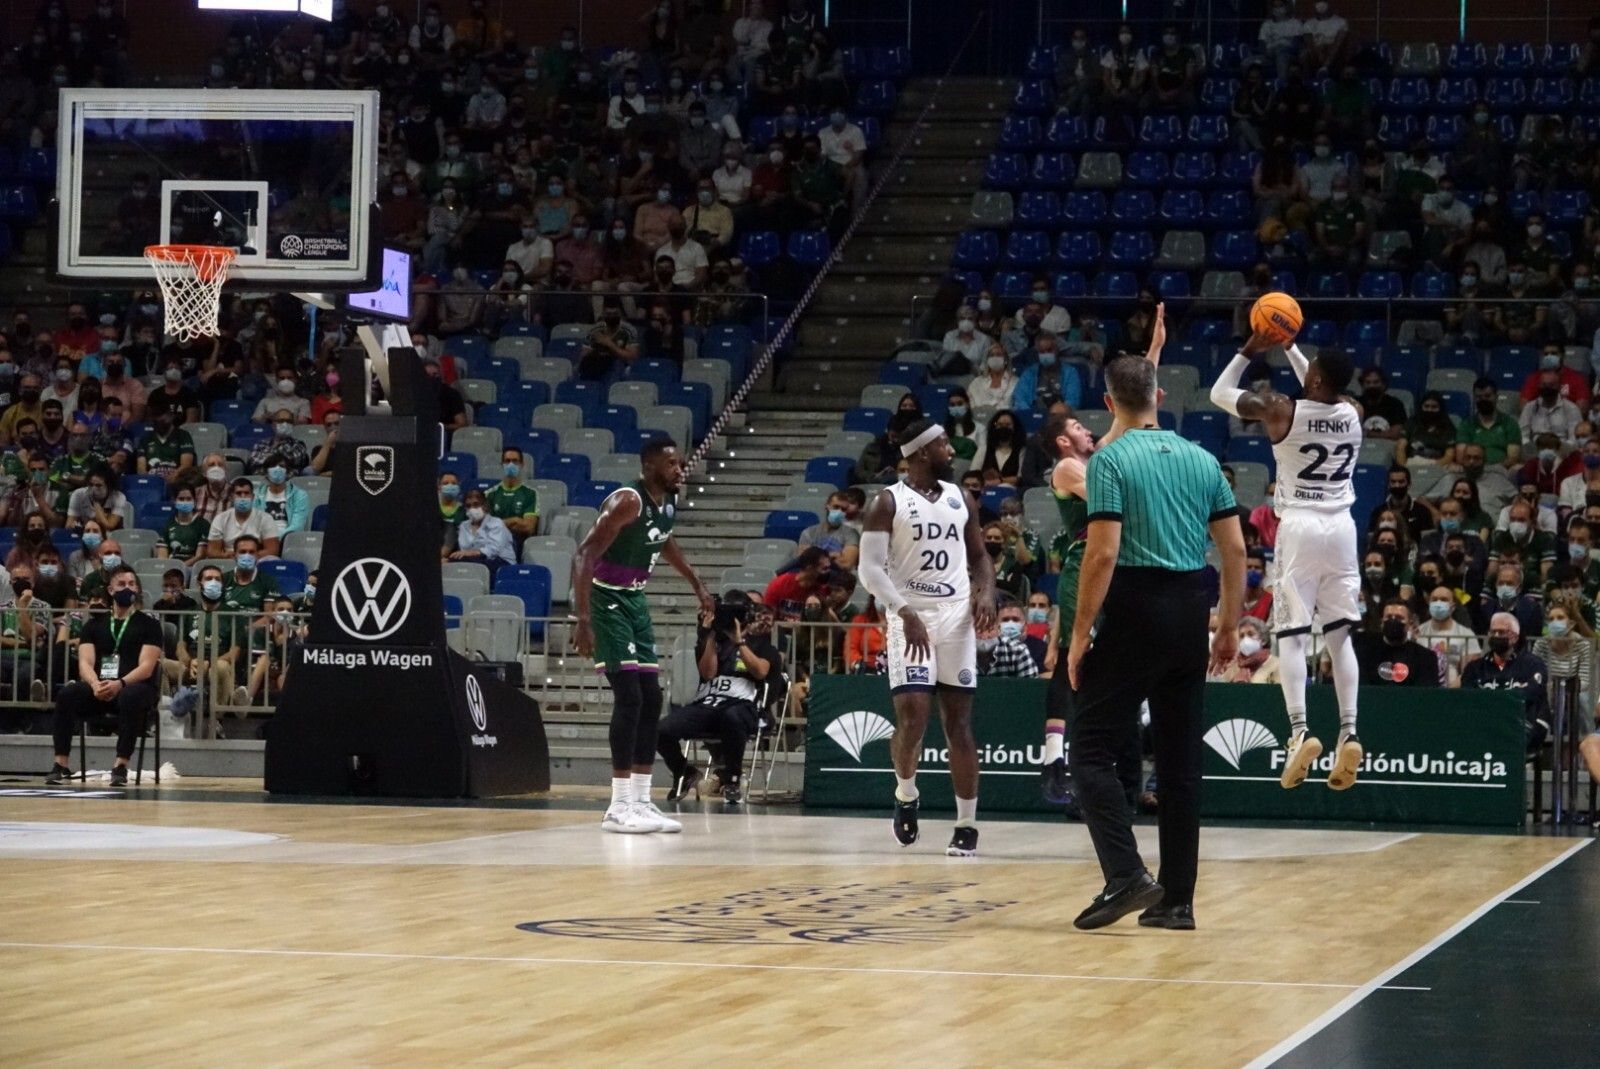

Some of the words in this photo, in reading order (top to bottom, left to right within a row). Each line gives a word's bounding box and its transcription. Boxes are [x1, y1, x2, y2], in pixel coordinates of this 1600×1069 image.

[1308, 419, 1351, 433] HENRY
[1297, 443, 1354, 481] 22
[912, 522, 959, 541] JDA
[920, 550, 949, 571] 20
[303, 648, 366, 669] Málaga
[370, 649, 433, 670] Wagen
